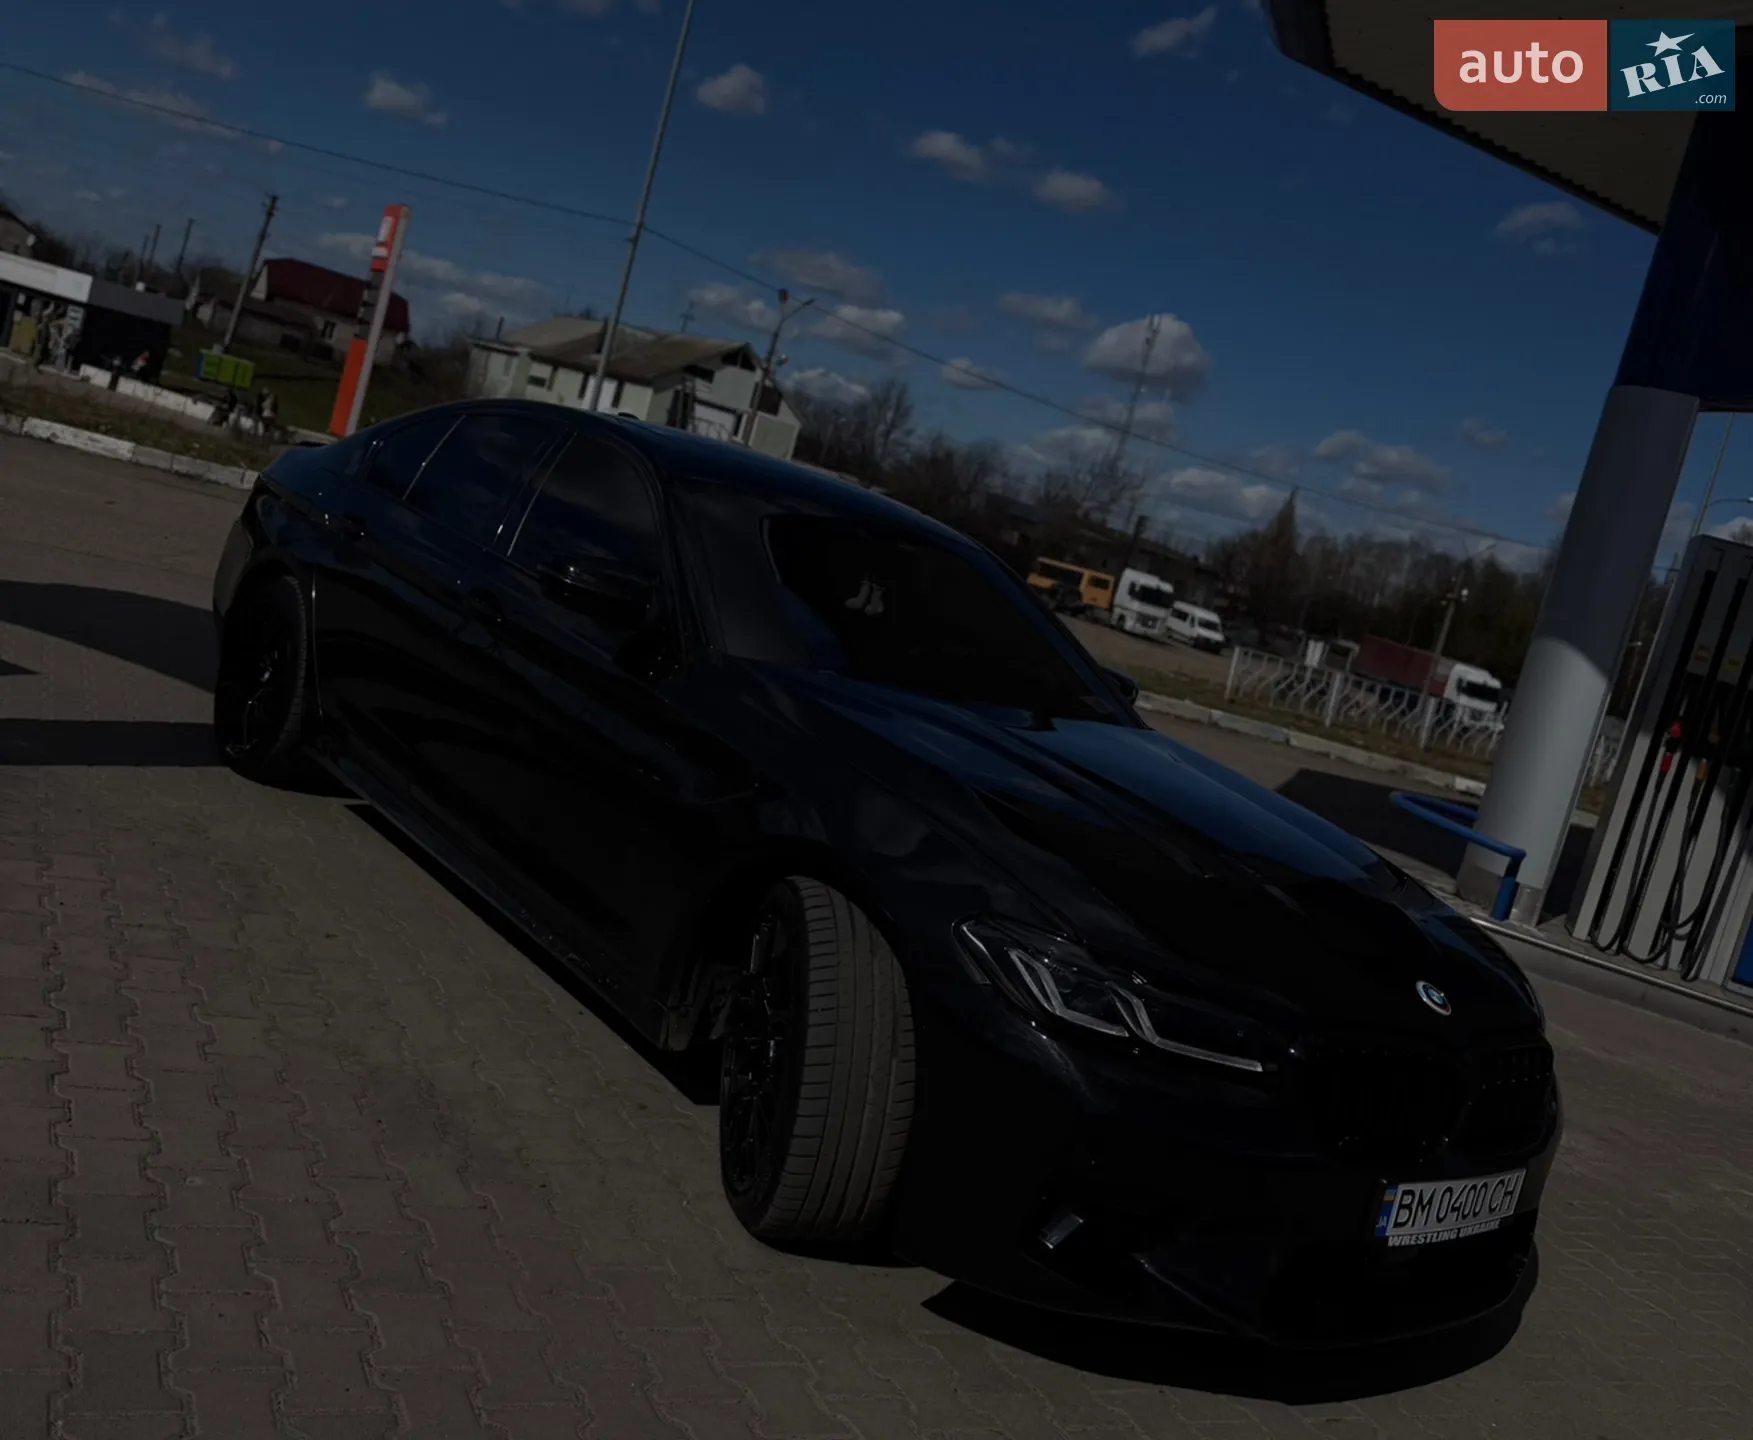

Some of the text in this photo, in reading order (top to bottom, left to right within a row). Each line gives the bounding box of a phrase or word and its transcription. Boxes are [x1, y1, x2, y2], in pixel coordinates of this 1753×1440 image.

[1393, 1173, 1520, 1228] BM 0400 CH
[1388, 1219, 1502, 1248] WRESTLING UKRAINE
